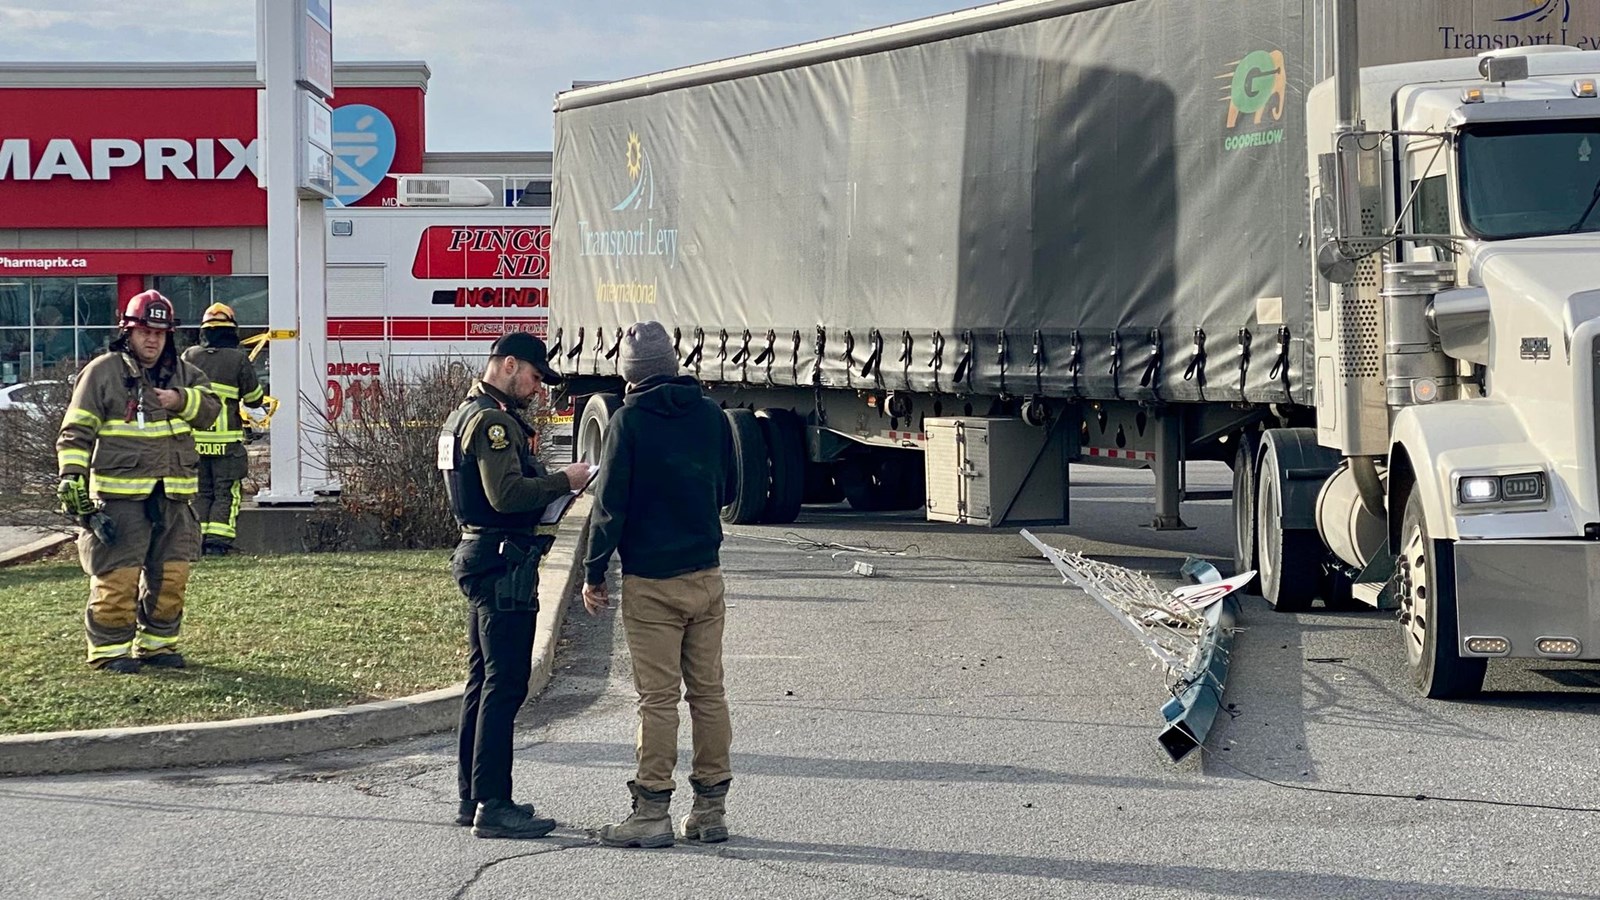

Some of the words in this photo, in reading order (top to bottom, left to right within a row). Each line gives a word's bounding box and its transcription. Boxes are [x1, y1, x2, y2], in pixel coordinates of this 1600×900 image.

[1439, 26, 1555, 50] Transport
[1225, 128, 1284, 151] GOODFELLOW
[578, 220, 644, 269] Transport
[647, 218, 678, 269] Levy
[596, 276, 658, 304] International
[150, 308, 166, 319] 151
